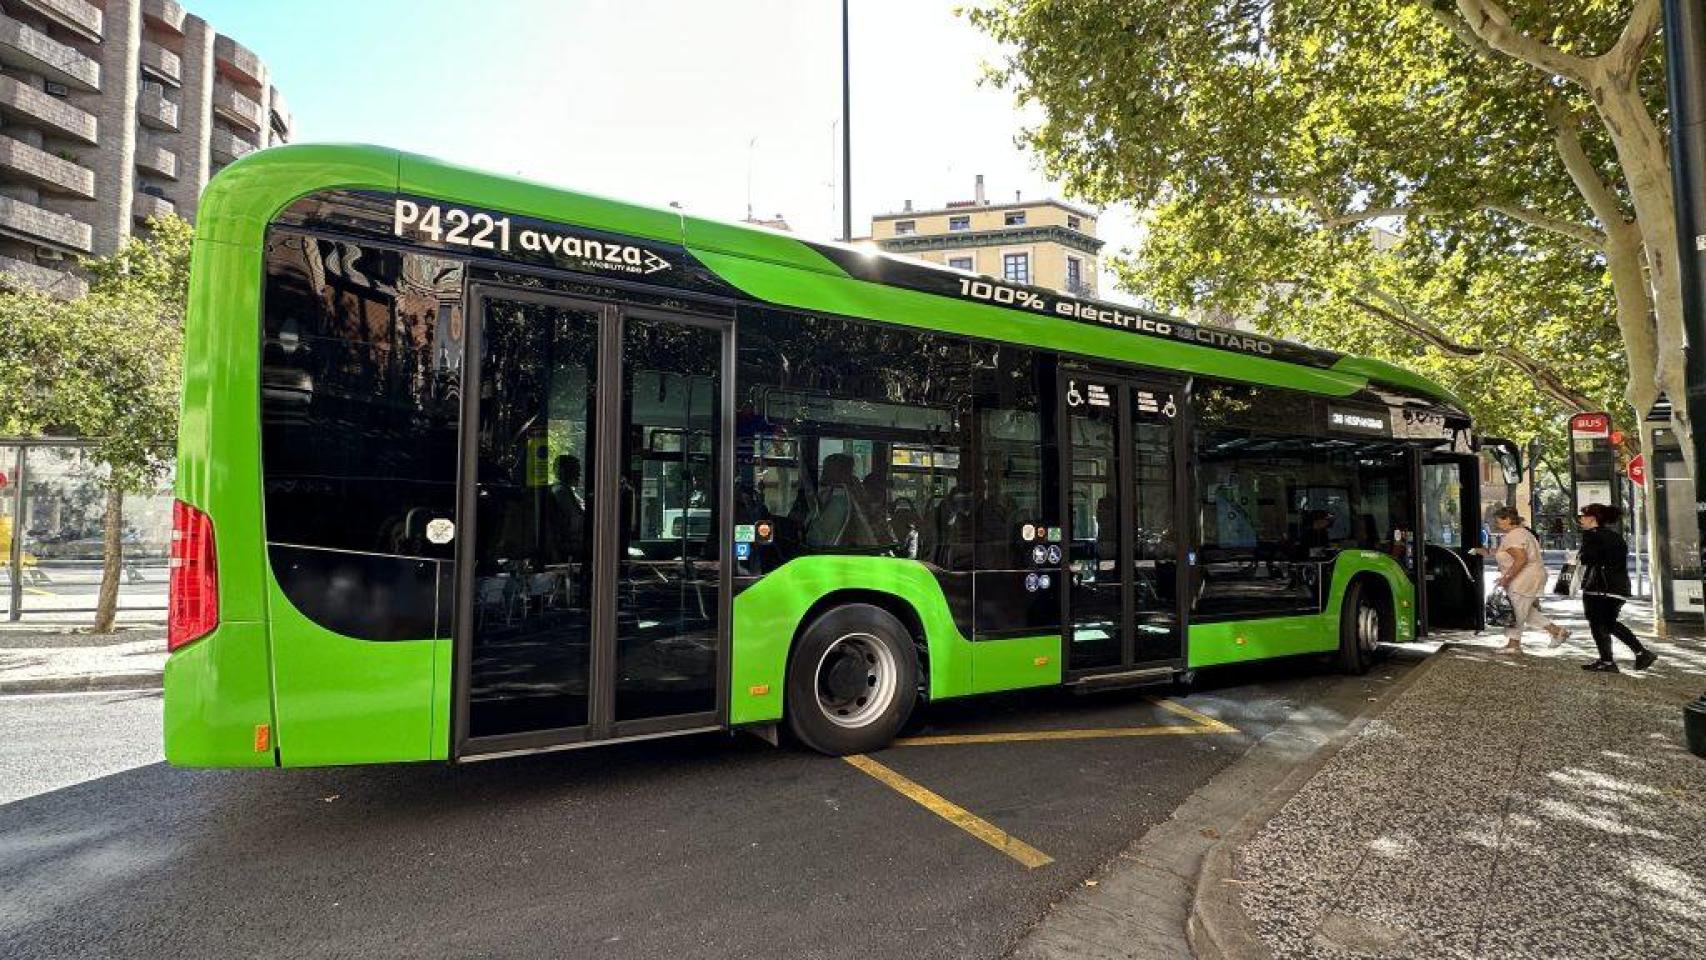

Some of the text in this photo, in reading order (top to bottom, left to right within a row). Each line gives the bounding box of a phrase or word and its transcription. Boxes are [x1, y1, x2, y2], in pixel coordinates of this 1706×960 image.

[394, 199, 511, 251] P4221
[519, 229, 641, 266] avanza
[959, 278, 1044, 310] 100%
[1056, 302, 1172, 335] eléctrico
[1577, 418, 1602, 428] BUS
